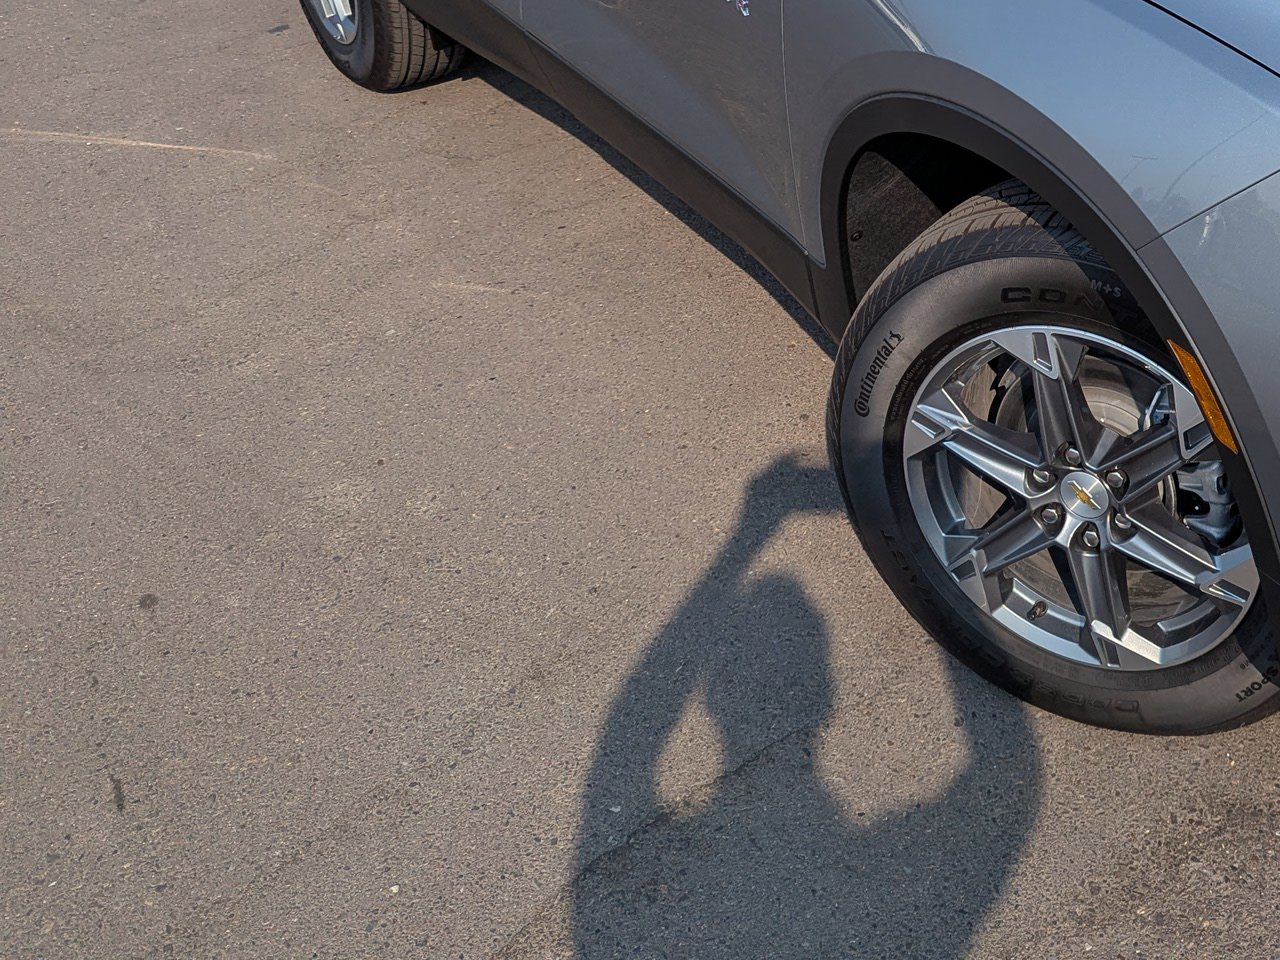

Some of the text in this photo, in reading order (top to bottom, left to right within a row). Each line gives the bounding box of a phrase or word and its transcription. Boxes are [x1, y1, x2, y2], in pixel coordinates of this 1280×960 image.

[1090, 279, 1122, 298] M+S
[854, 336, 896, 418] Continental
[1234, 665, 1280, 704] SPORT
